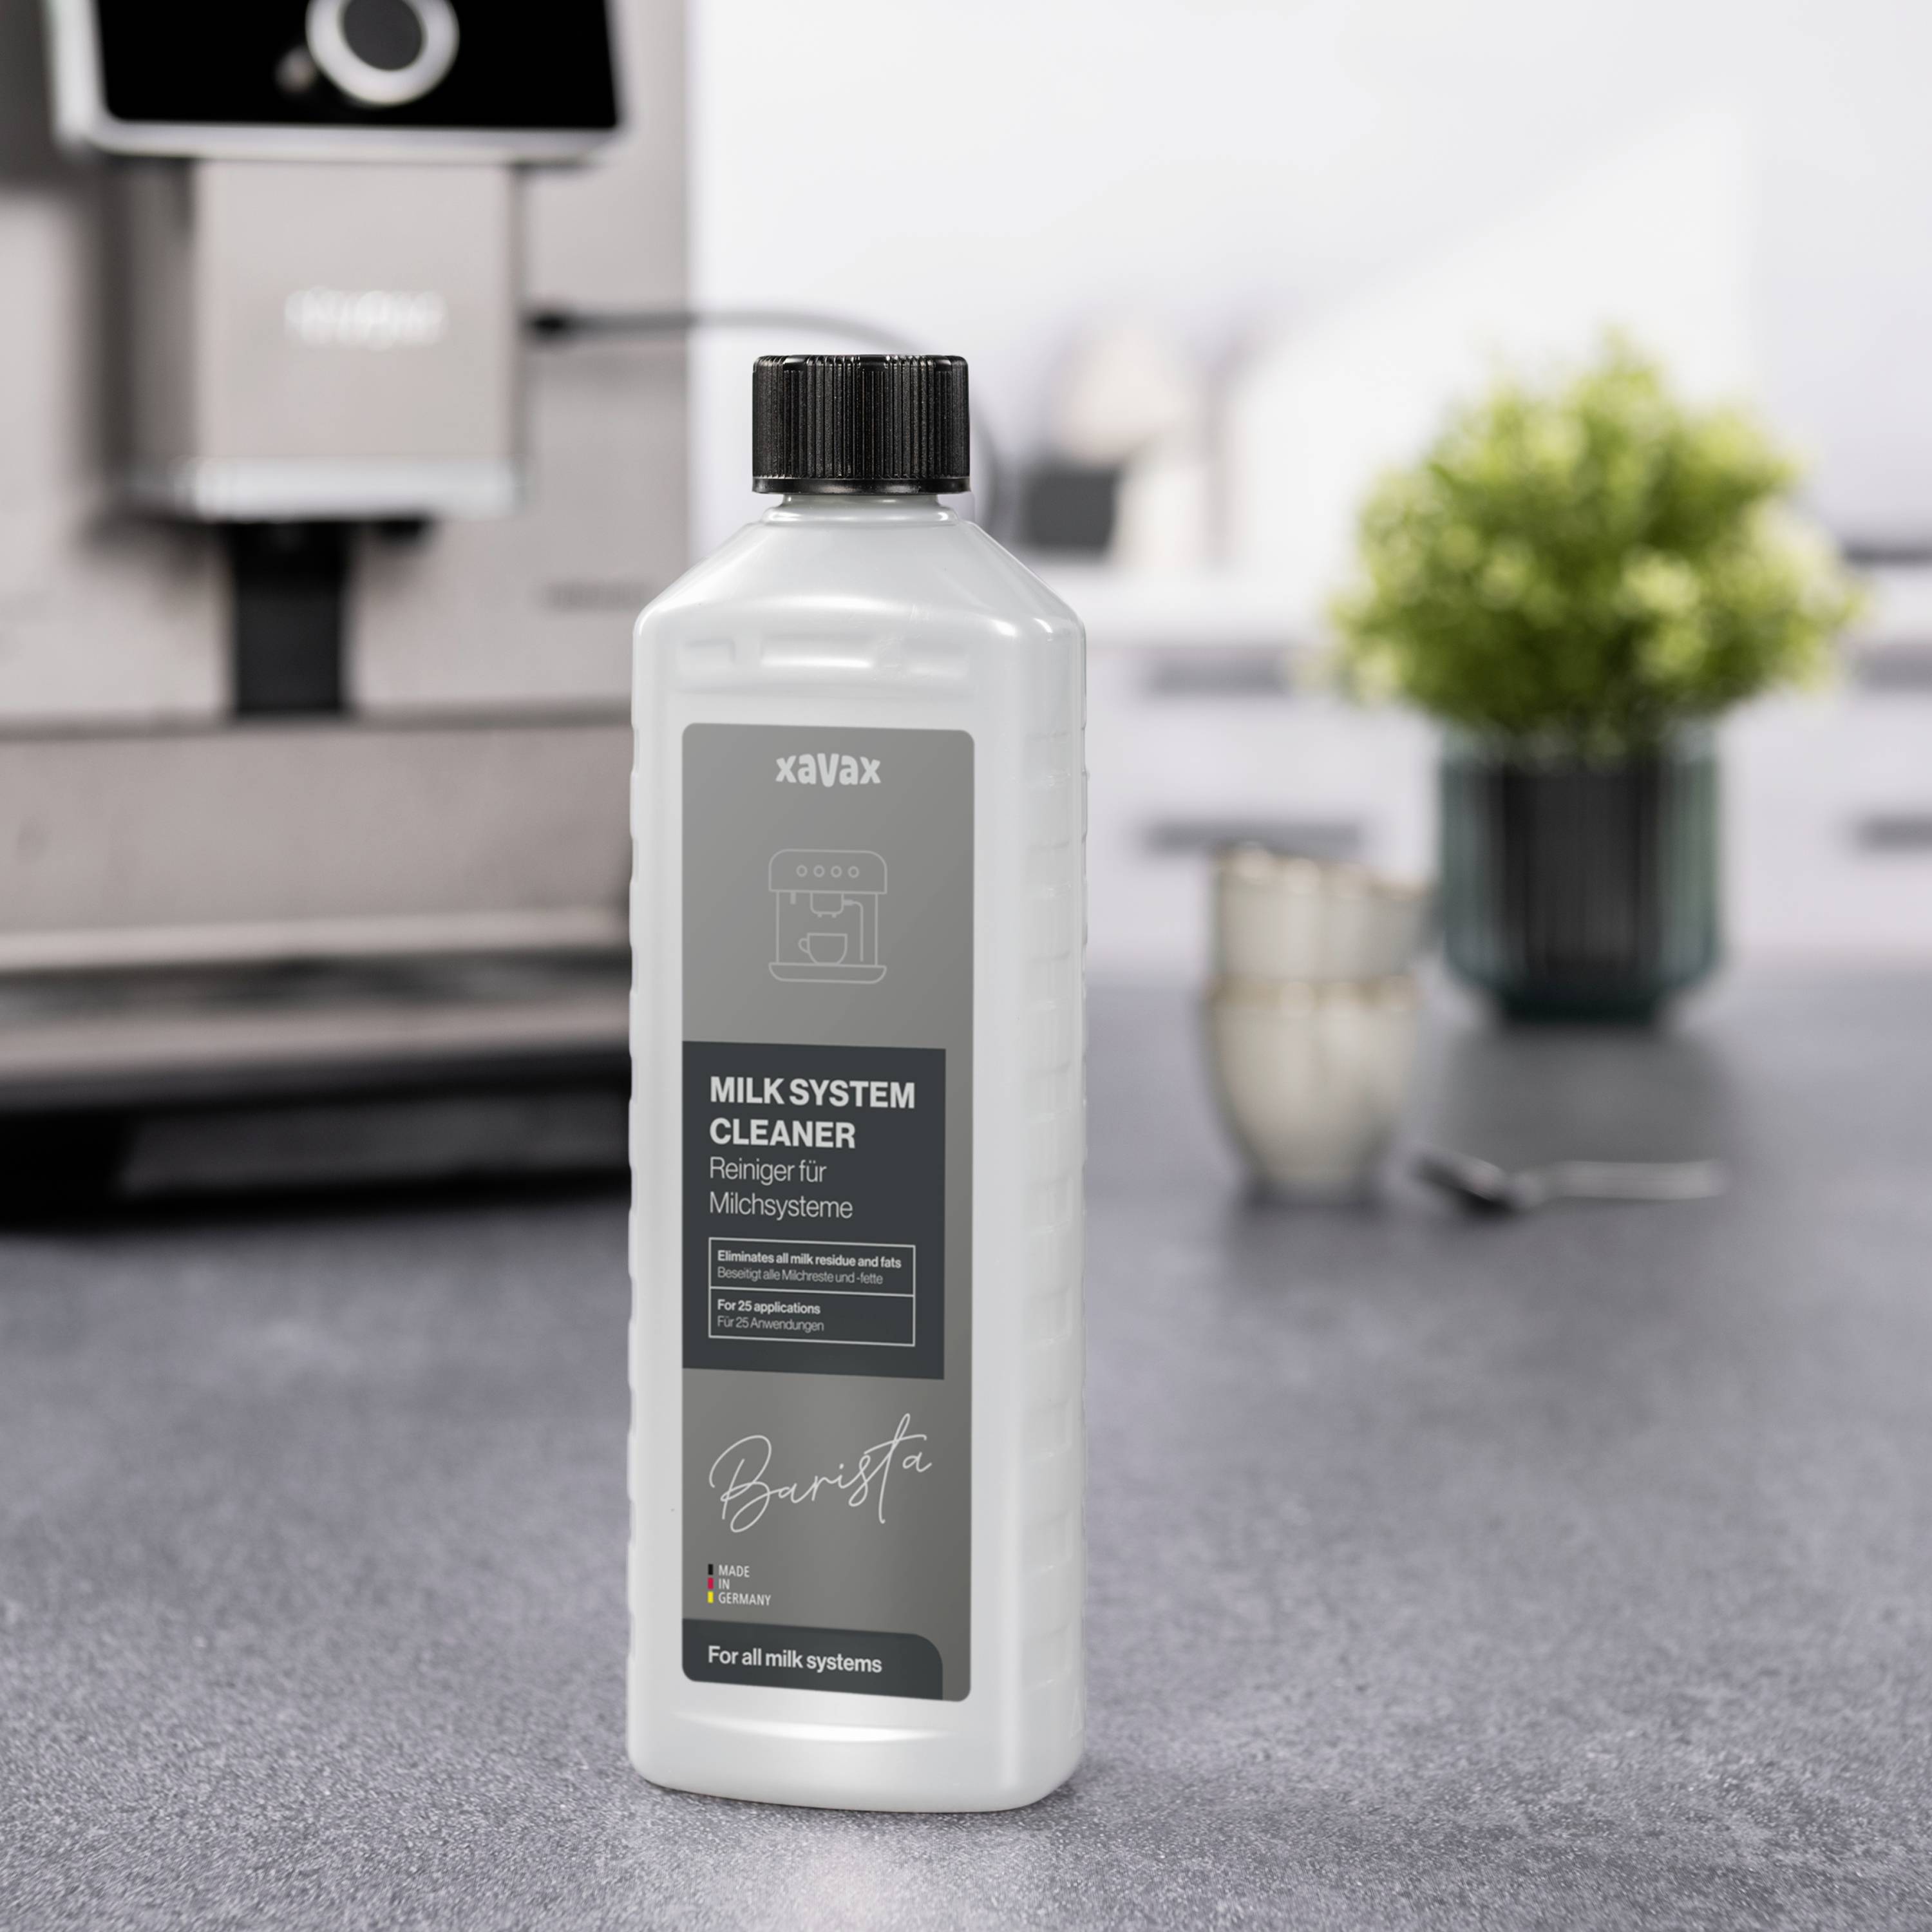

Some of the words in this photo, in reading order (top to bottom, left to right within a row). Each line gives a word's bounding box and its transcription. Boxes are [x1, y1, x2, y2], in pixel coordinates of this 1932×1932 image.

[710, 1076, 784, 1104] MILK
[790, 1079, 914, 1108] SYSTEM
[710, 1117, 855, 1148] CLEANER
[710, 1157, 795, 1185] Reiniger
[799, 1160, 827, 1182] für
[710, 1191, 853, 1221] Milchsysteme
[717, 1250, 774, 1264] Eliminates
[776, 1253, 788, 1264] all
[791, 1253, 813, 1265] milk
[815, 1254, 856, 1267] residue
[858, 1256, 878, 1267] and
[880, 1256, 901, 1268] fats
[717, 1267, 761, 1282] Beseitigt
[762, 1269, 781, 1280] alle
[782, 1270, 833, 1282] Milchreste
[835, 1271, 855, 1283] und
[857, 1273, 883, 1285] -fette
[717, 1299, 736, 1311] For
[738, 1300, 752, 1311] 25
[753, 1301, 820, 1314] applications
[717, 1316, 734, 1328] Für
[736, 1318, 749, 1328] 25
[750, 1318, 824, 1333] Anwendungen
[709, 1413, 932, 1533] Barista
[719, 1565, 750, 1577] MADE
[719, 1578, 730, 1589] IN
[718, 1592, 771, 1605] GERMANY
[708, 1645, 738, 1664] For
[742, 1647, 761, 1665] all
[766, 1650, 803, 1668] milk
[806, 1653, 882, 1672] systems
